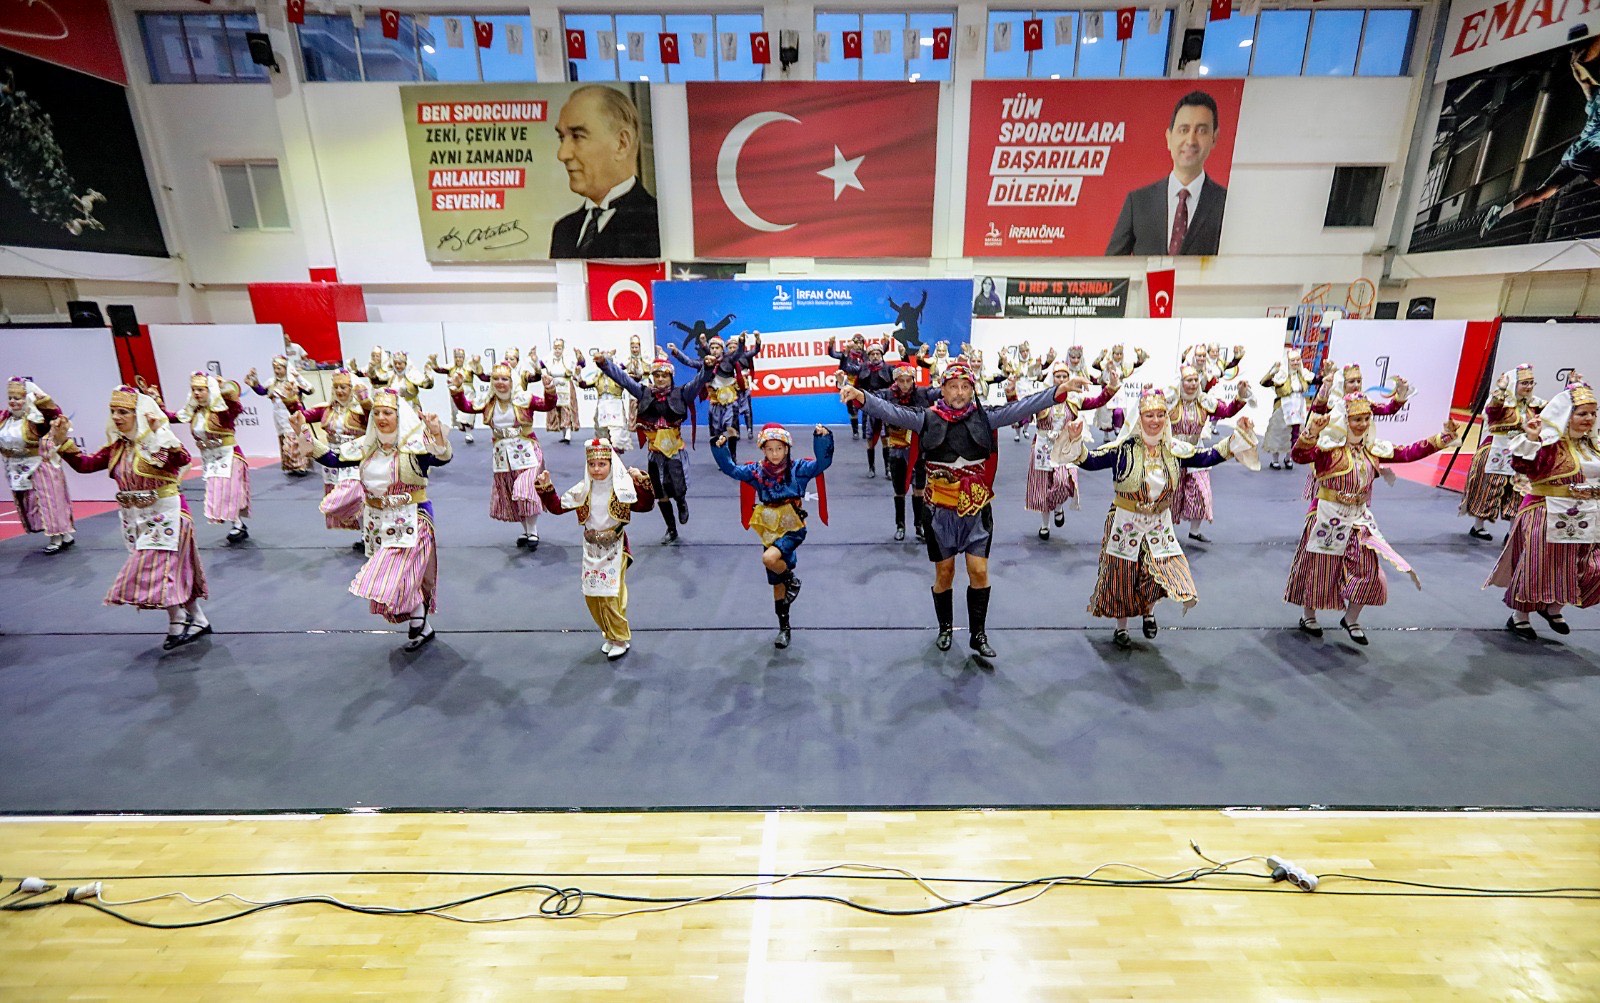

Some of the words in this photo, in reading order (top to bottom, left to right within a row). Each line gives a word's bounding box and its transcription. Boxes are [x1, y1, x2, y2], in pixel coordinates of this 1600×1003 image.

[422, 105, 450, 122] BEN
[453, 103, 542, 121] SPORCUNUN
[1001, 93, 1043, 119] TÜM
[426, 123, 460, 144] ZEKİ,
[465, 123, 506, 144] ÇEVİK
[511, 127, 527, 140] VE
[999, 121, 1125, 143] SPORCULARA
[429, 150, 461, 164] AYNI
[466, 149, 533, 163] ZAMANDA
[997, 150, 1104, 172] BAŞARILAR
[432, 170, 520, 187] AHLAKLISINI
[994, 178, 1075, 202] DİLERİM.
[436, 190, 501, 210] SEVERİM.
[1008, 224, 1039, 239] İRFAN
[1039, 224, 1065, 239] ÖNAL
[796, 288, 823, 300] İRFAN
[825, 288, 852, 300] ÖNAL
[1019, 281, 1026, 293] O
[1029, 281, 1048, 294] HEP
[1052, 281, 1063, 294] 15
[1067, 281, 1113, 296] YAŞINDA!
[1007, 295, 1023, 307] ESKİ
[1069, 295, 1086, 307] NİSA
[1028, 306, 1060, 316] SAYGIYLA
